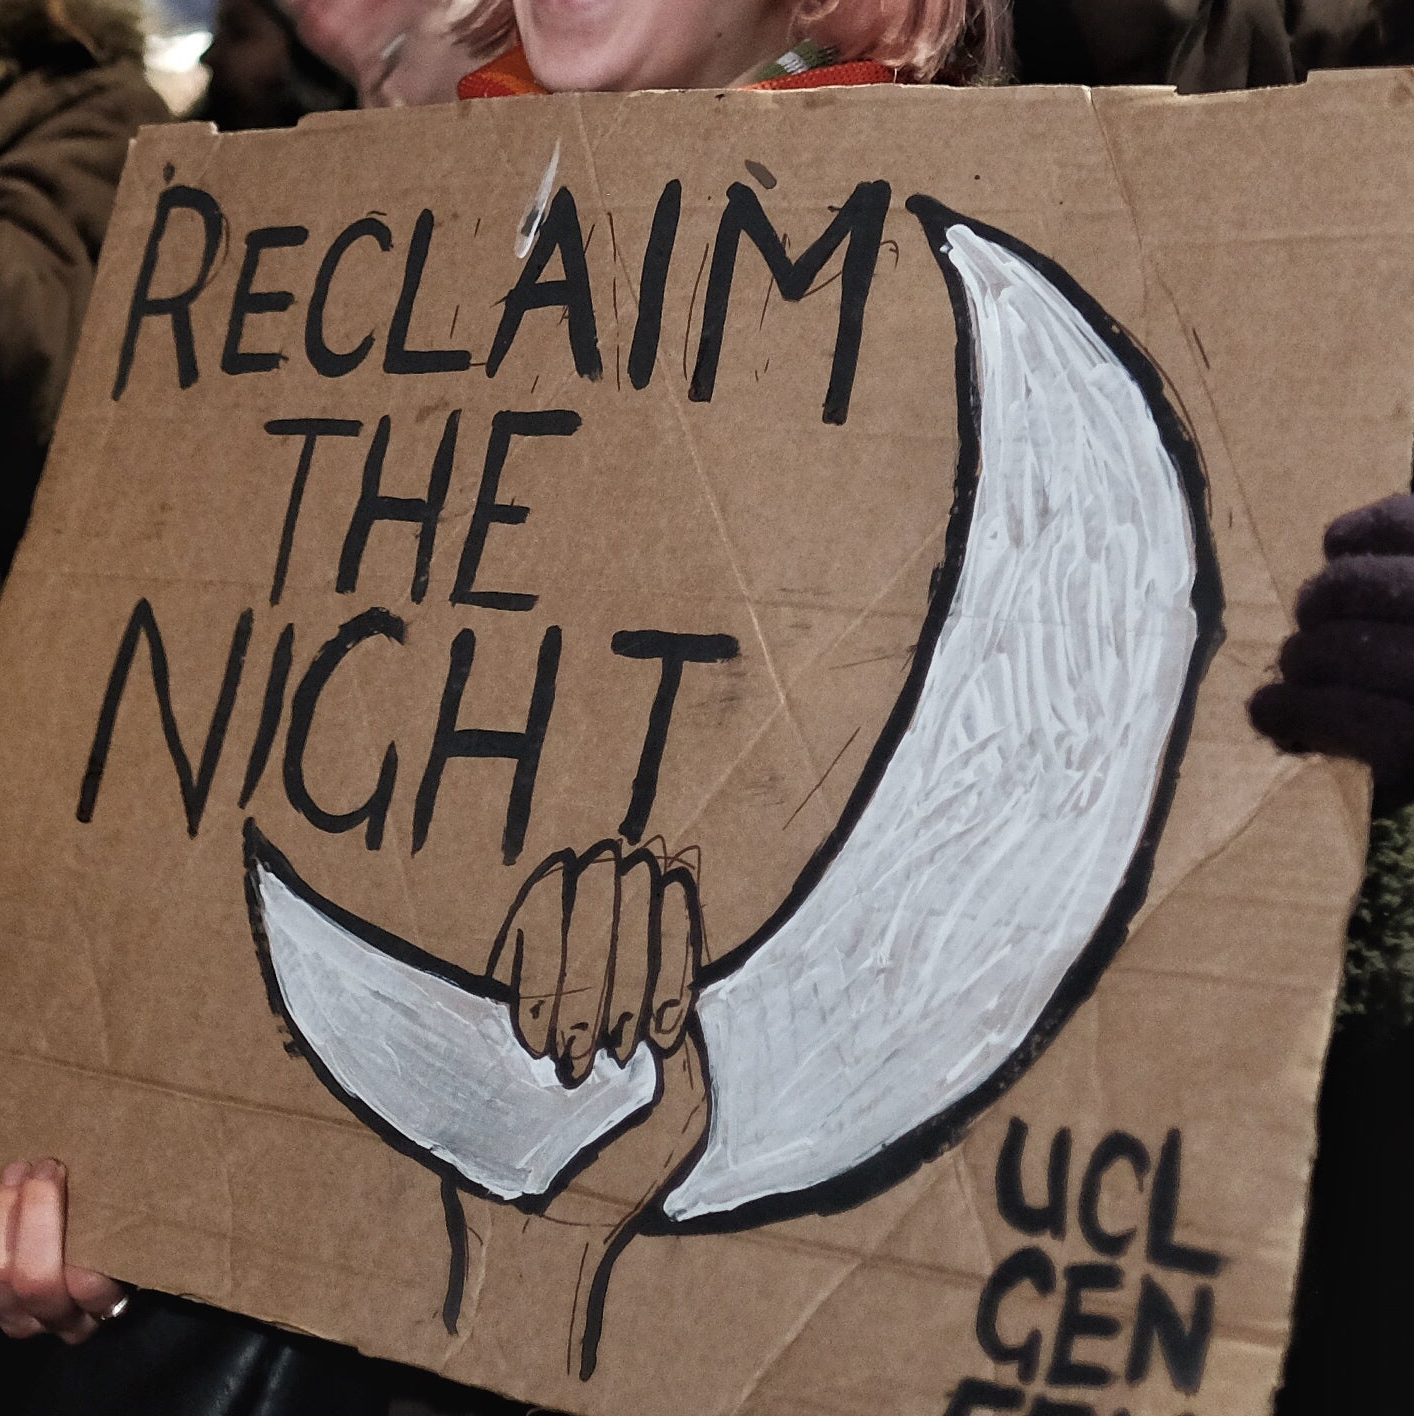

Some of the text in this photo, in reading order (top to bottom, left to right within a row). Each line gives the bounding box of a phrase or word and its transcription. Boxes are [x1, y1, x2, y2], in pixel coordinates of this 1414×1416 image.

[112, 176, 893, 426] RECLAIM
[264, 409, 583, 611] THE
[76, 598, 739, 865] NIGHT
[995, 1116, 1229, 1277] UCL
[975, 1245, 1216, 1397] GEN
